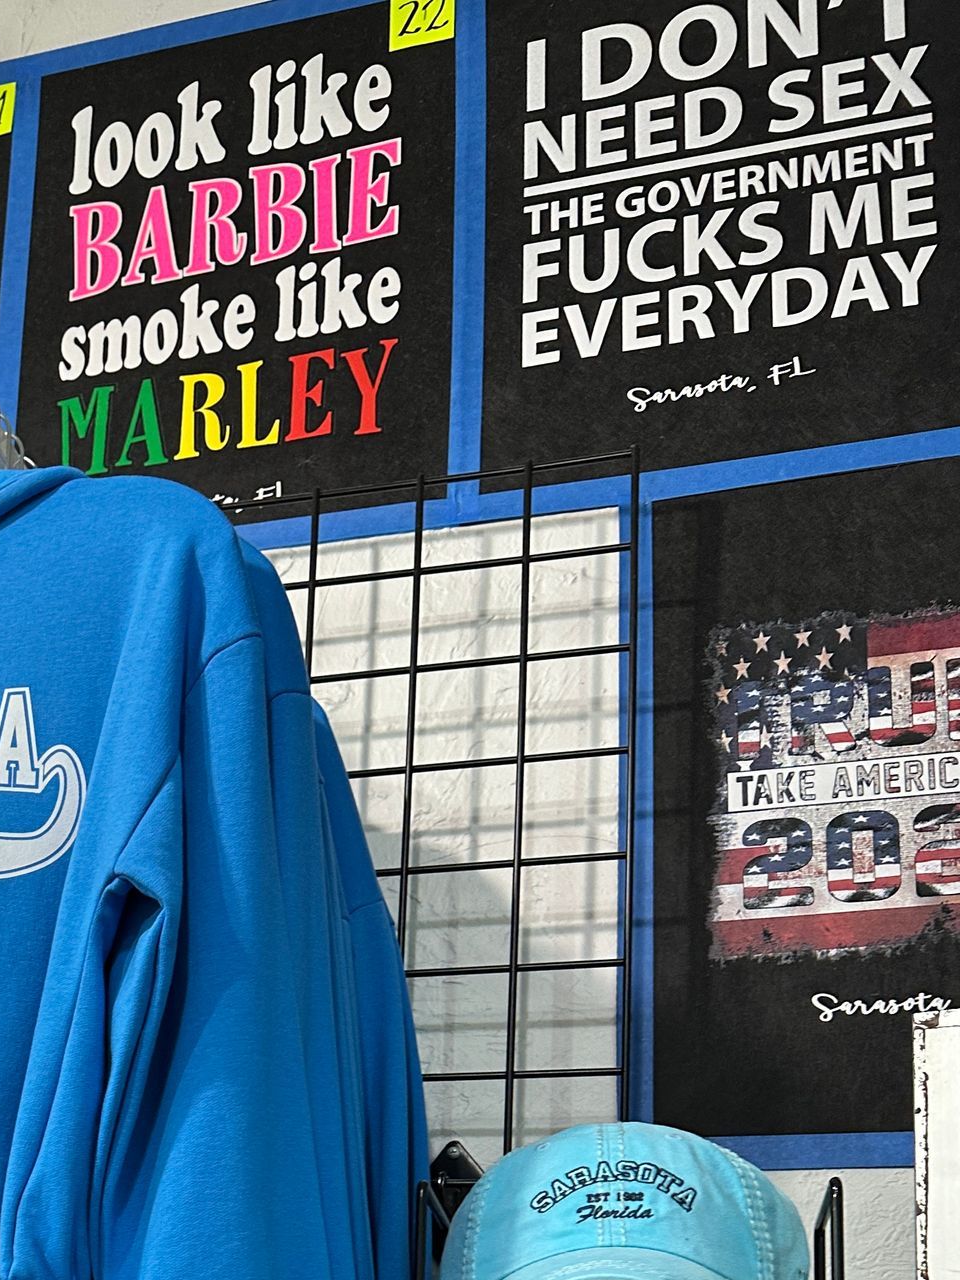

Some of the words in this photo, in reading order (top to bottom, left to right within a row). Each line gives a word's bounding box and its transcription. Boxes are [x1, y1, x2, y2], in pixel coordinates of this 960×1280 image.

[398, 0, 449, 36] 22
[526, 38, 546, 112] I
[582, 0, 906, 101] DON
[69, 80, 226, 195] look
[247, 53, 392, 156] like
[523, 86, 742, 181] NEED
[767, 44, 932, 133] SEX
[69, 137, 401, 302] BARBIE
[523, 192, 604, 235] THE
[615, 132, 934, 219] GOVERNMENT
[522, 200, 785, 304] FUCKS
[809, 173, 938, 256] ME
[58, 284, 256, 381] smoke
[274, 256, 401, 342] like
[521, 244, 938, 369] EVERYDAY
[57, 338, 399, 476] MARLEY
[627, 373, 757, 413] Sarasota,
[767, 355, 817, 385] FL
[728, 658, 960, 756] TRU
[736, 769, 817, 807] TAKE
[831, 756, 960, 799] AMERIC
[811, 992, 951, 1021] Sarasota
[530, 1160, 698, 1213] SARASOTA
[576, 1204, 655, 1224] Florida
[586, 1192, 610, 1203] EST
